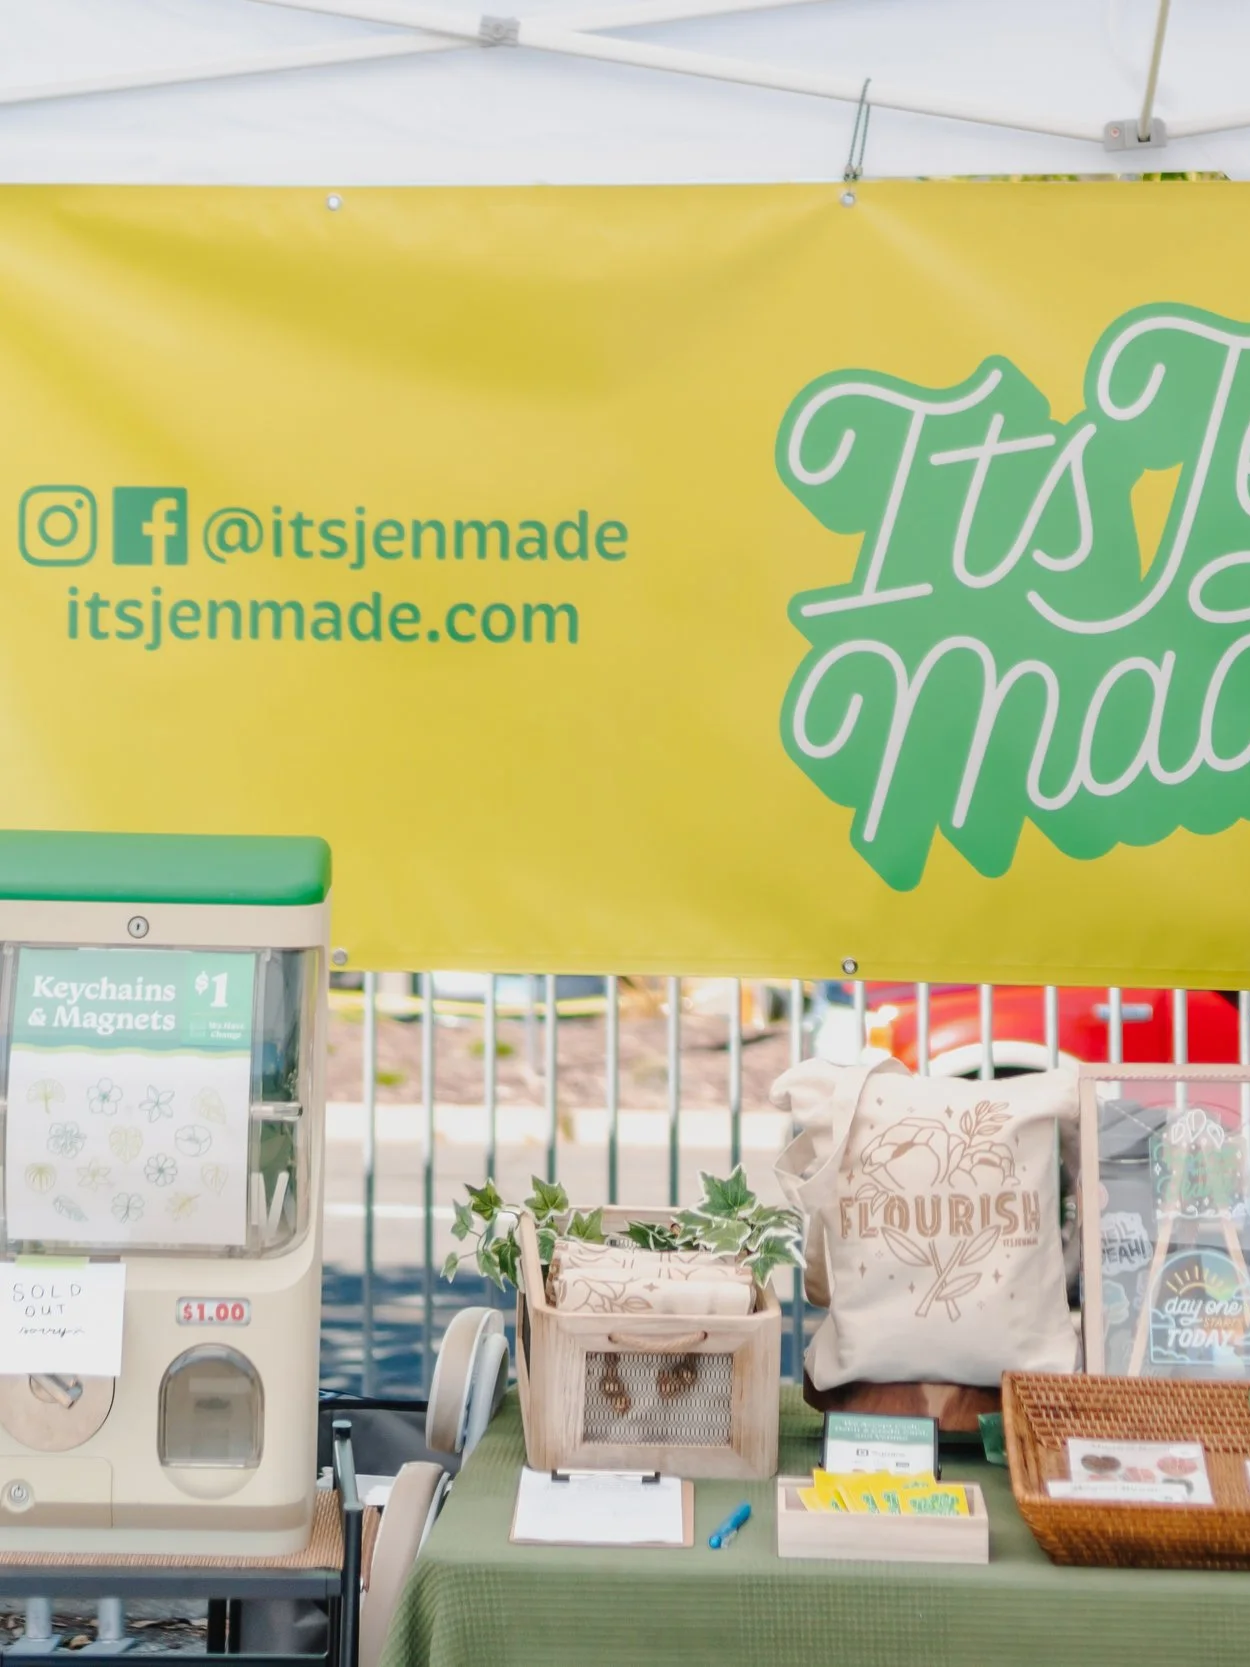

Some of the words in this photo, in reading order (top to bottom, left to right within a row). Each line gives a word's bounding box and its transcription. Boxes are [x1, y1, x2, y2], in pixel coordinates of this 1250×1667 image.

[788, 368, 1097, 618] Its
[203, 505, 629, 571] @itsjenmade
[67, 586, 579, 652] itsjenmade.com
[32, 974, 176, 1005] Keychains
[194, 970, 229, 1008] $1
[28, 1008, 46, 1027] &
[53, 1005, 176, 1035] Magnets
[838, 1191, 1041, 1240] FLOURISH
[12, 1282, 82, 1302] SOLD
[24, 1303, 65, 1318] OUT
[183, 1302, 245, 1321] $1.00
[1164, 1296, 1203, 1326] day
[1204, 1299, 1243, 1316] one
[1167, 1328, 1234, 1349] TODAY
